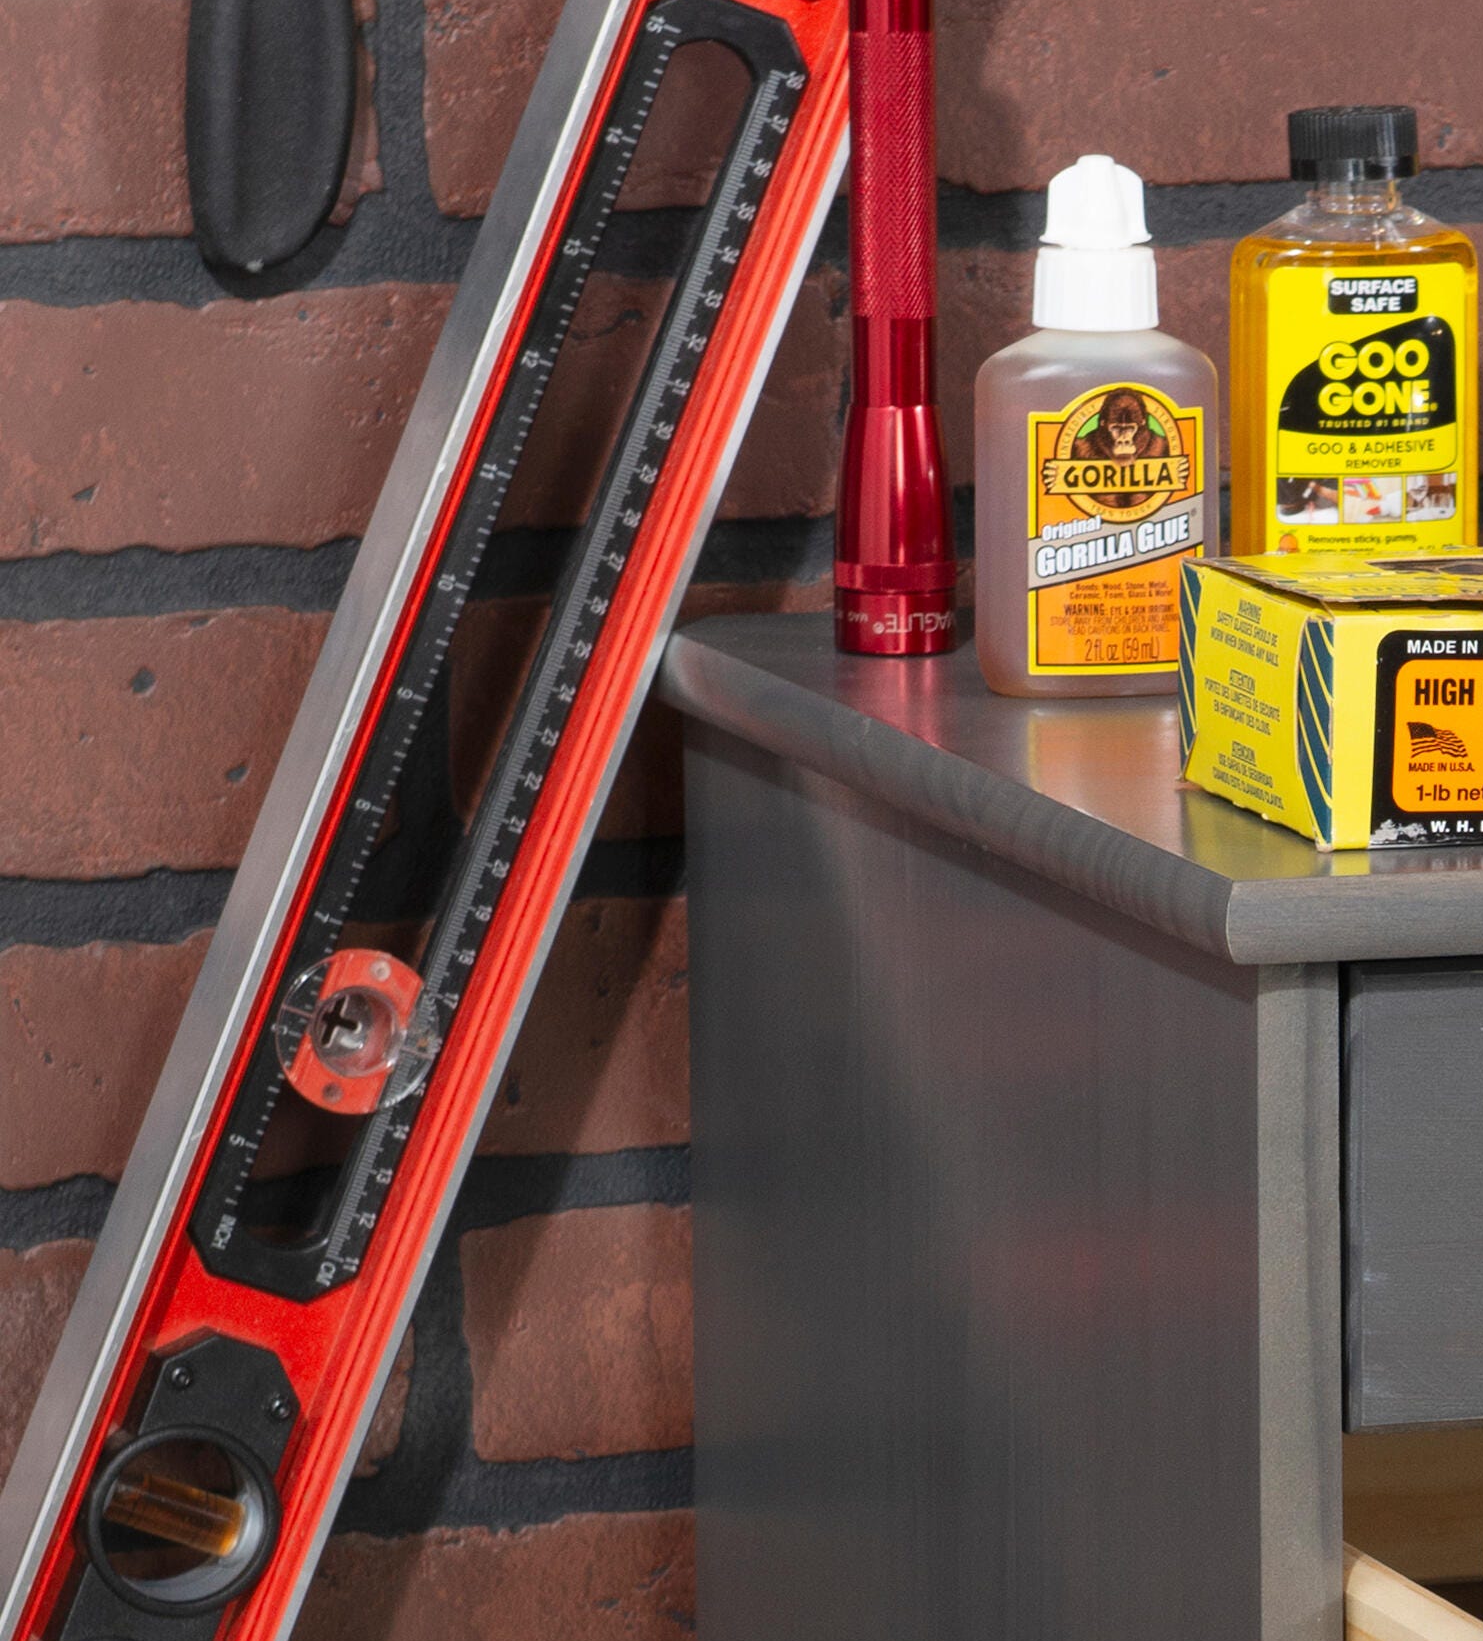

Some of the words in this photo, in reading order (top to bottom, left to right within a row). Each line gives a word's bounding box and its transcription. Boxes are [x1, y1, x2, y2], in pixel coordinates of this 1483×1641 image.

[1330, 278, 1416, 297] SURFACE
[1350, 296, 1402, 313] SAFE
[1318, 339, 1430, 380] GOO
[1318, 419, 1372, 428] TRUSTED
[1375, 419, 1389, 428] #1
[1391, 417, 1430, 427] BRAND
[1306, 441, 1344, 455] GOO
[1348, 442, 1357, 454] &
[1363, 438, 1435, 454] ADHESIVE
[1345, 458, 1401, 469] REMOVER
[1064, 461, 1173, 490] GORILLA
[1041, 515, 1101, 542] Original
[1406, 639, 1457, 655] MADE
[1461, 639, 1479, 655] IN
[1414, 678, 1475, 706] HIGH
[1408, 761, 1436, 773] MADE
[1437, 761, 1448, 772] IN
[1449, 761, 1475, 772] U.S.A.
[1415, 783, 1451, 802] 1-lb
[1430, 820, 1451, 833] W.
[1456, 820, 1475, 833] H.
